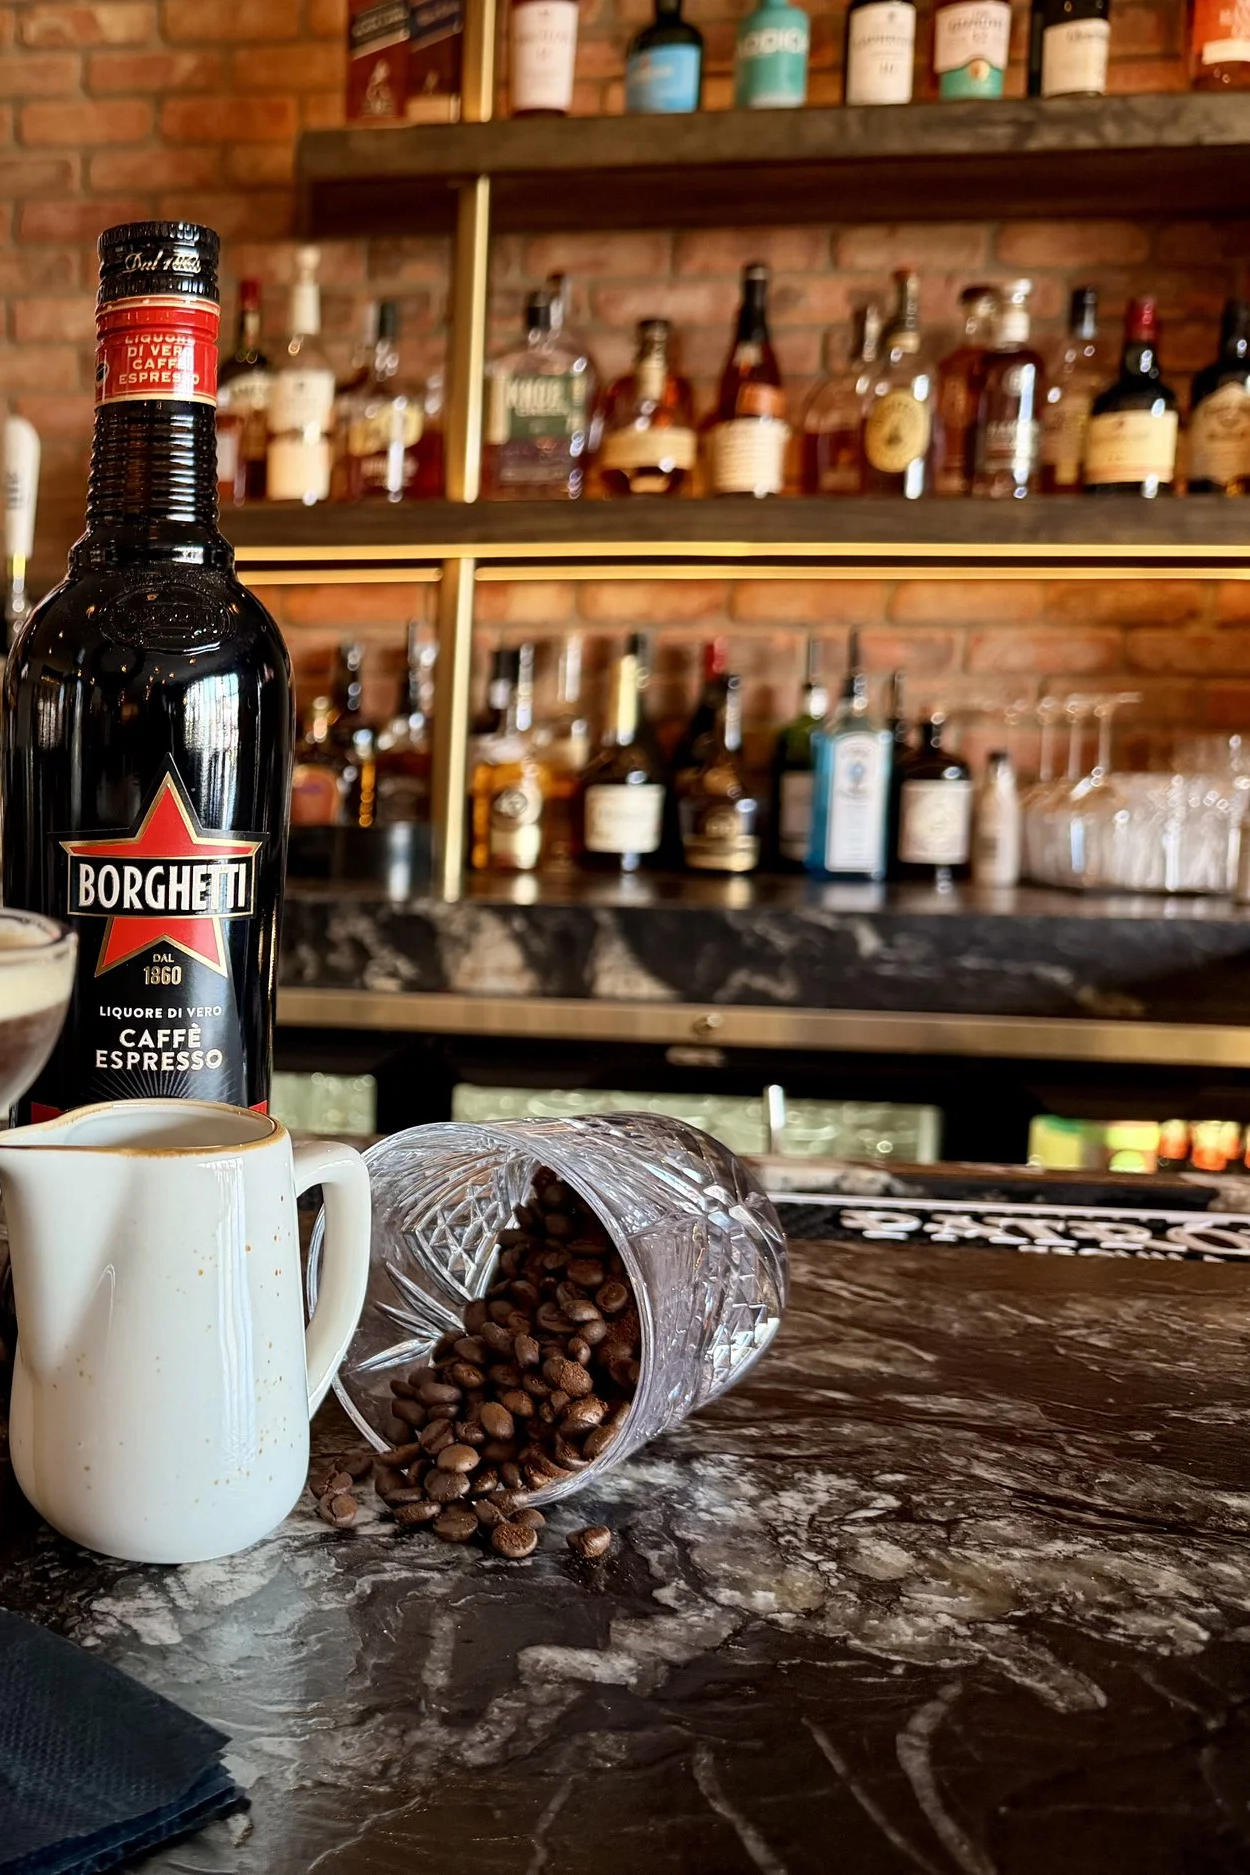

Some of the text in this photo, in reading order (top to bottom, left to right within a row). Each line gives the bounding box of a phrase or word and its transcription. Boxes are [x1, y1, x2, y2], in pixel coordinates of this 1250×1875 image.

[127, 345, 143, 358] DI
[132, 357, 186, 371] CAFF
[77, 862, 247, 912] BORGHETTI
[152, 952, 175, 964] DAL
[143, 965, 182, 986] 1860
[99, 1005, 223, 1020] LIQUORE DI VERO
[118, 1023, 201, 1049] CAFFÈ
[95, 1049, 223, 1072] ESPRESSO
